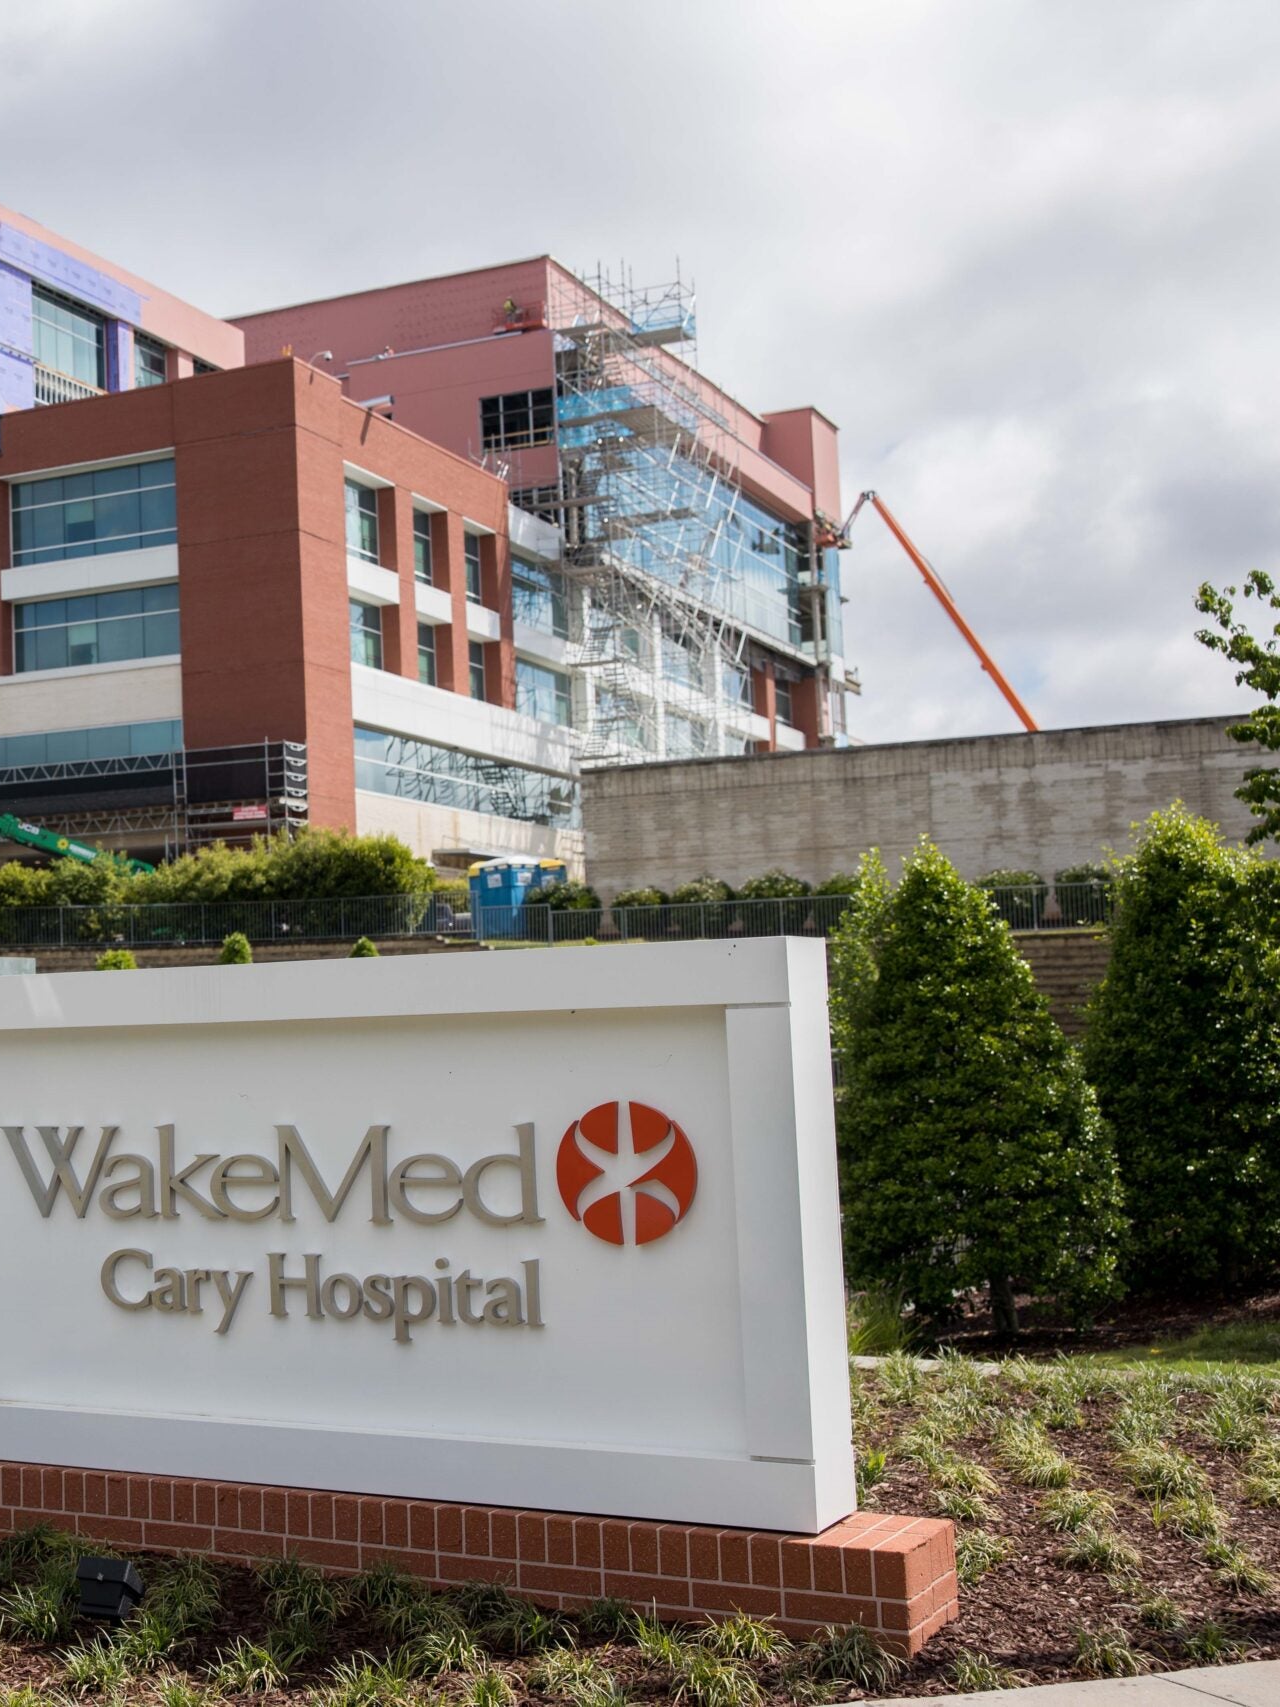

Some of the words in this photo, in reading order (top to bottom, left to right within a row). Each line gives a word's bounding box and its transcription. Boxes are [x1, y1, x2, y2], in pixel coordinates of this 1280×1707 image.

[18, 823, 40, 835] JCB
[0, 1121, 546, 1226] WakeMed
[100, 1248, 252, 1334] Cary
[267, 1252, 545, 1344] Hospital
